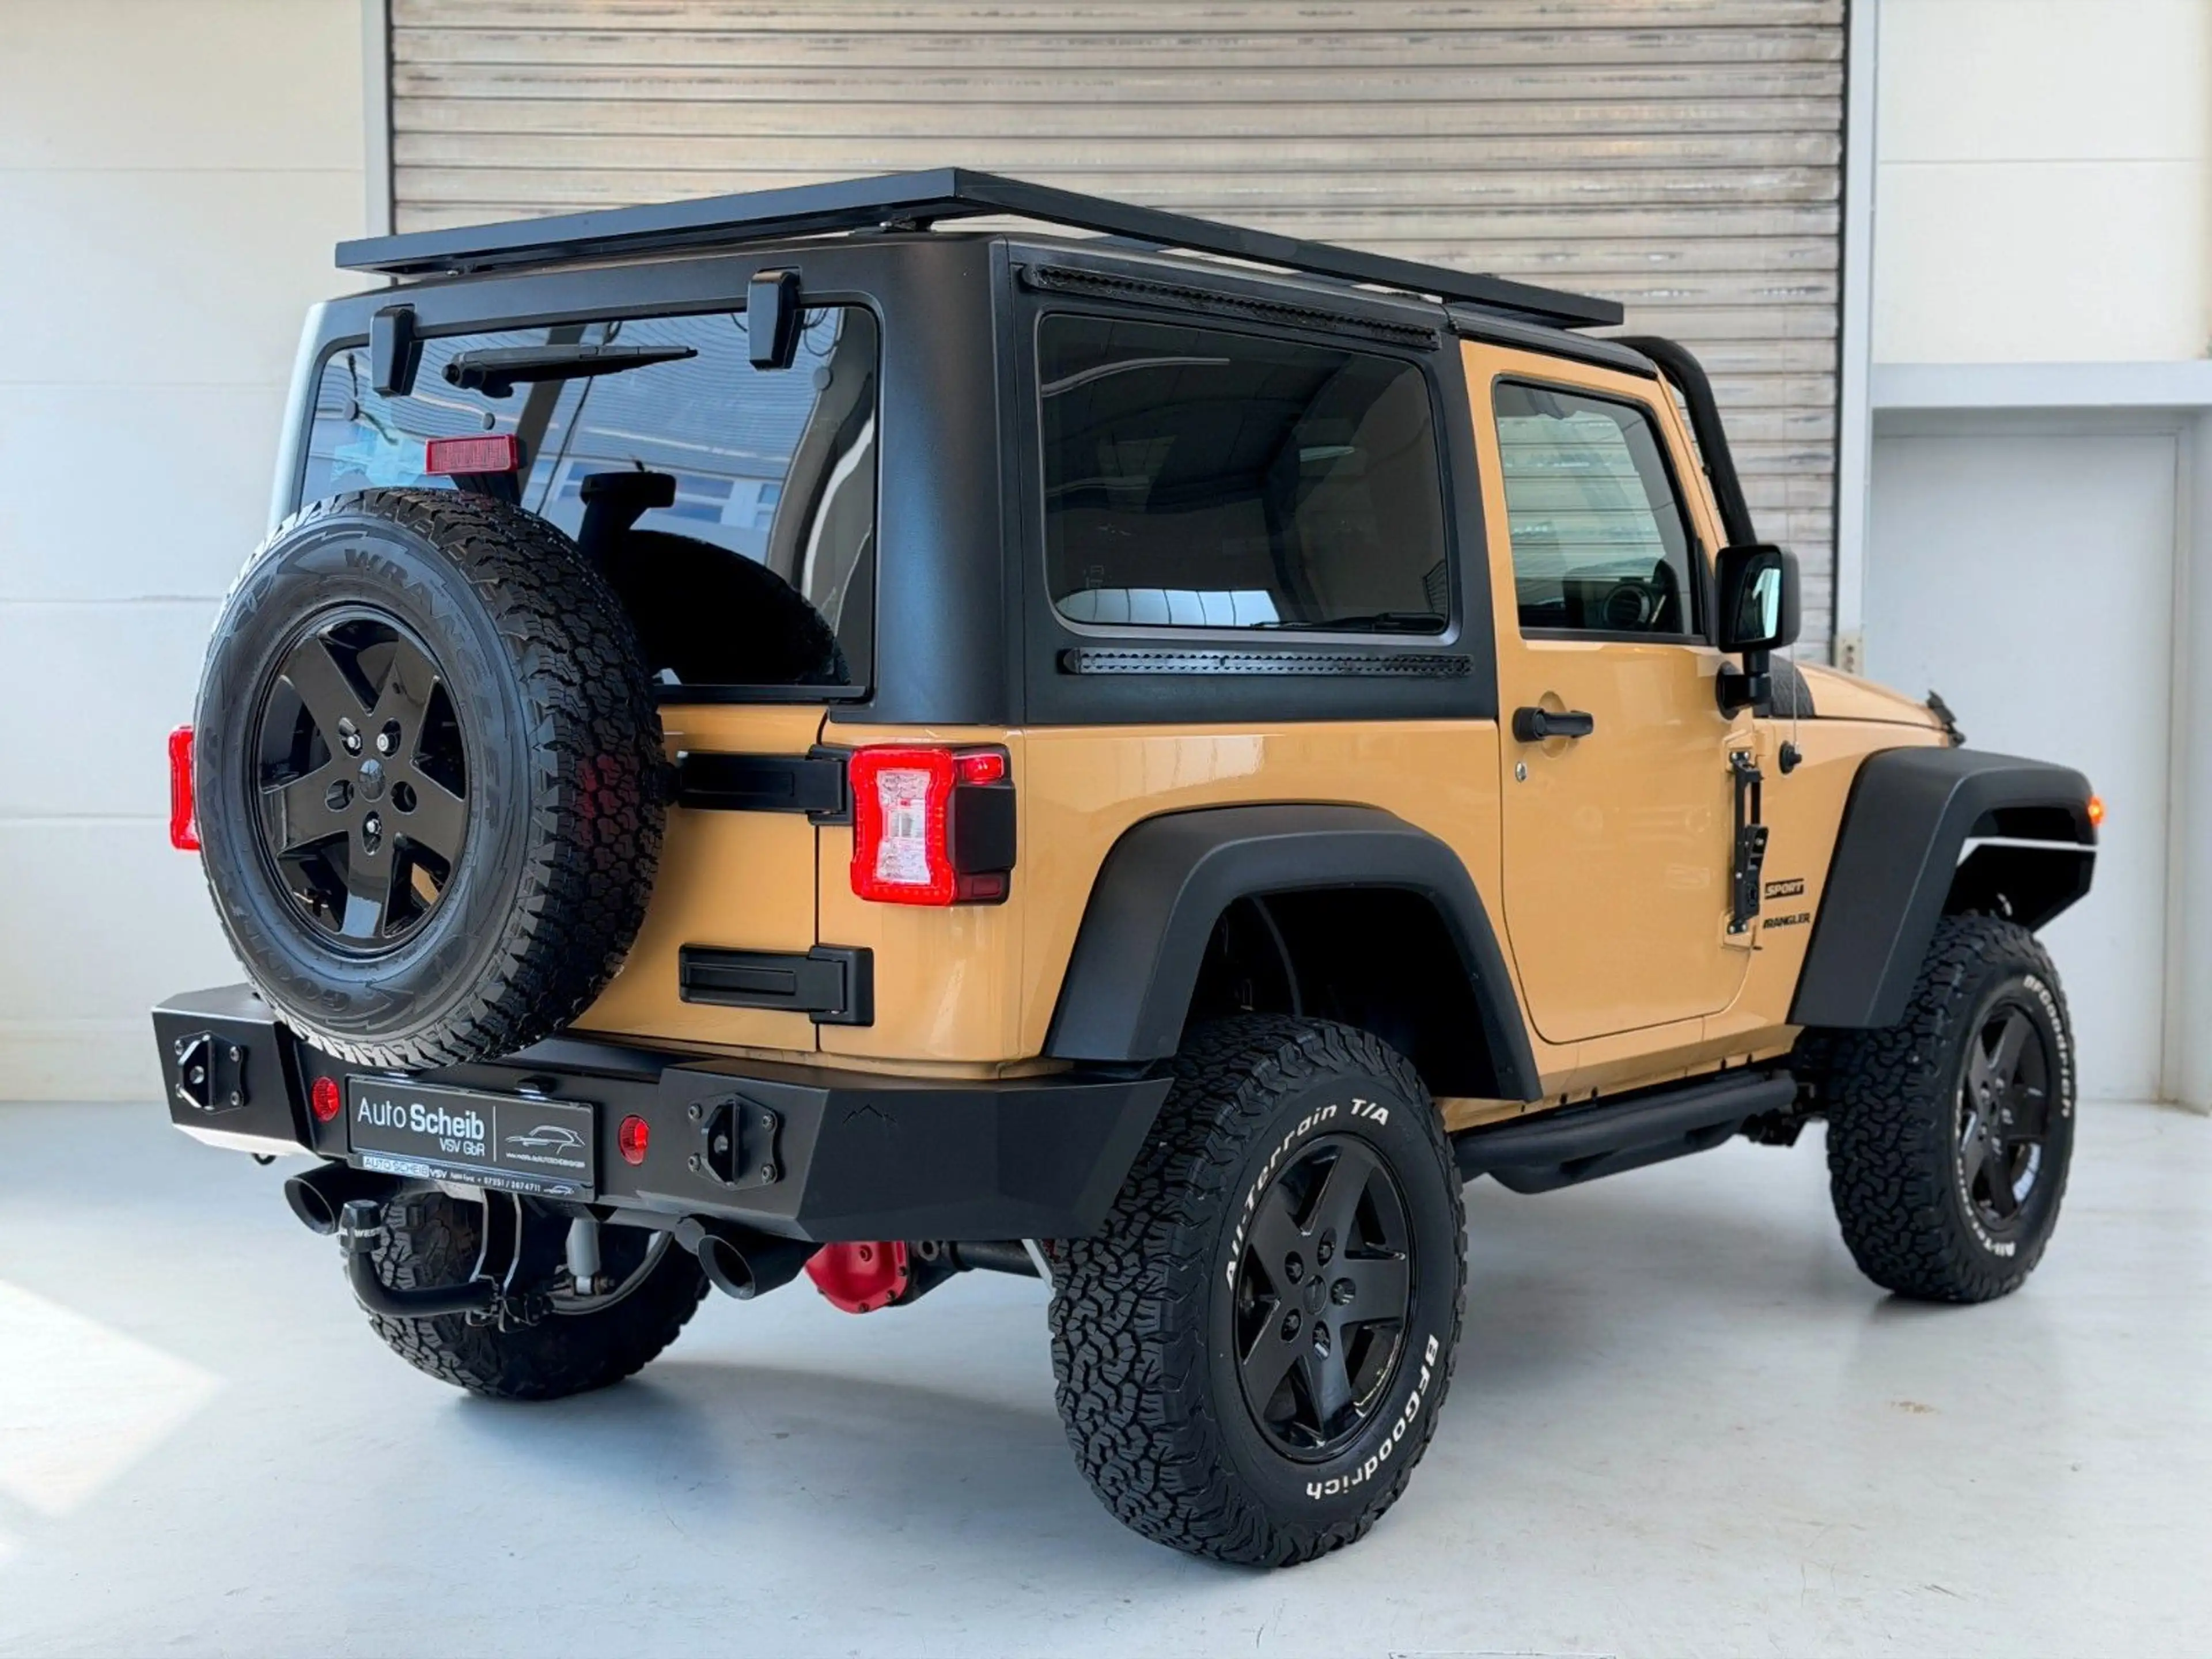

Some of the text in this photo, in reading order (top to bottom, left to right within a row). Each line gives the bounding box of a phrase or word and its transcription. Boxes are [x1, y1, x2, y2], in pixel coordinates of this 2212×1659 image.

[1766, 881, 1803, 896] SPORT
[357, 1097, 485, 1140] Auto Scheib
[439, 1138, 485, 1157] VSV GbR
[1226, 1098, 1389, 1290] All-Terrain T/A
[1306, 1334, 1439, 1499] BFGoodrich
